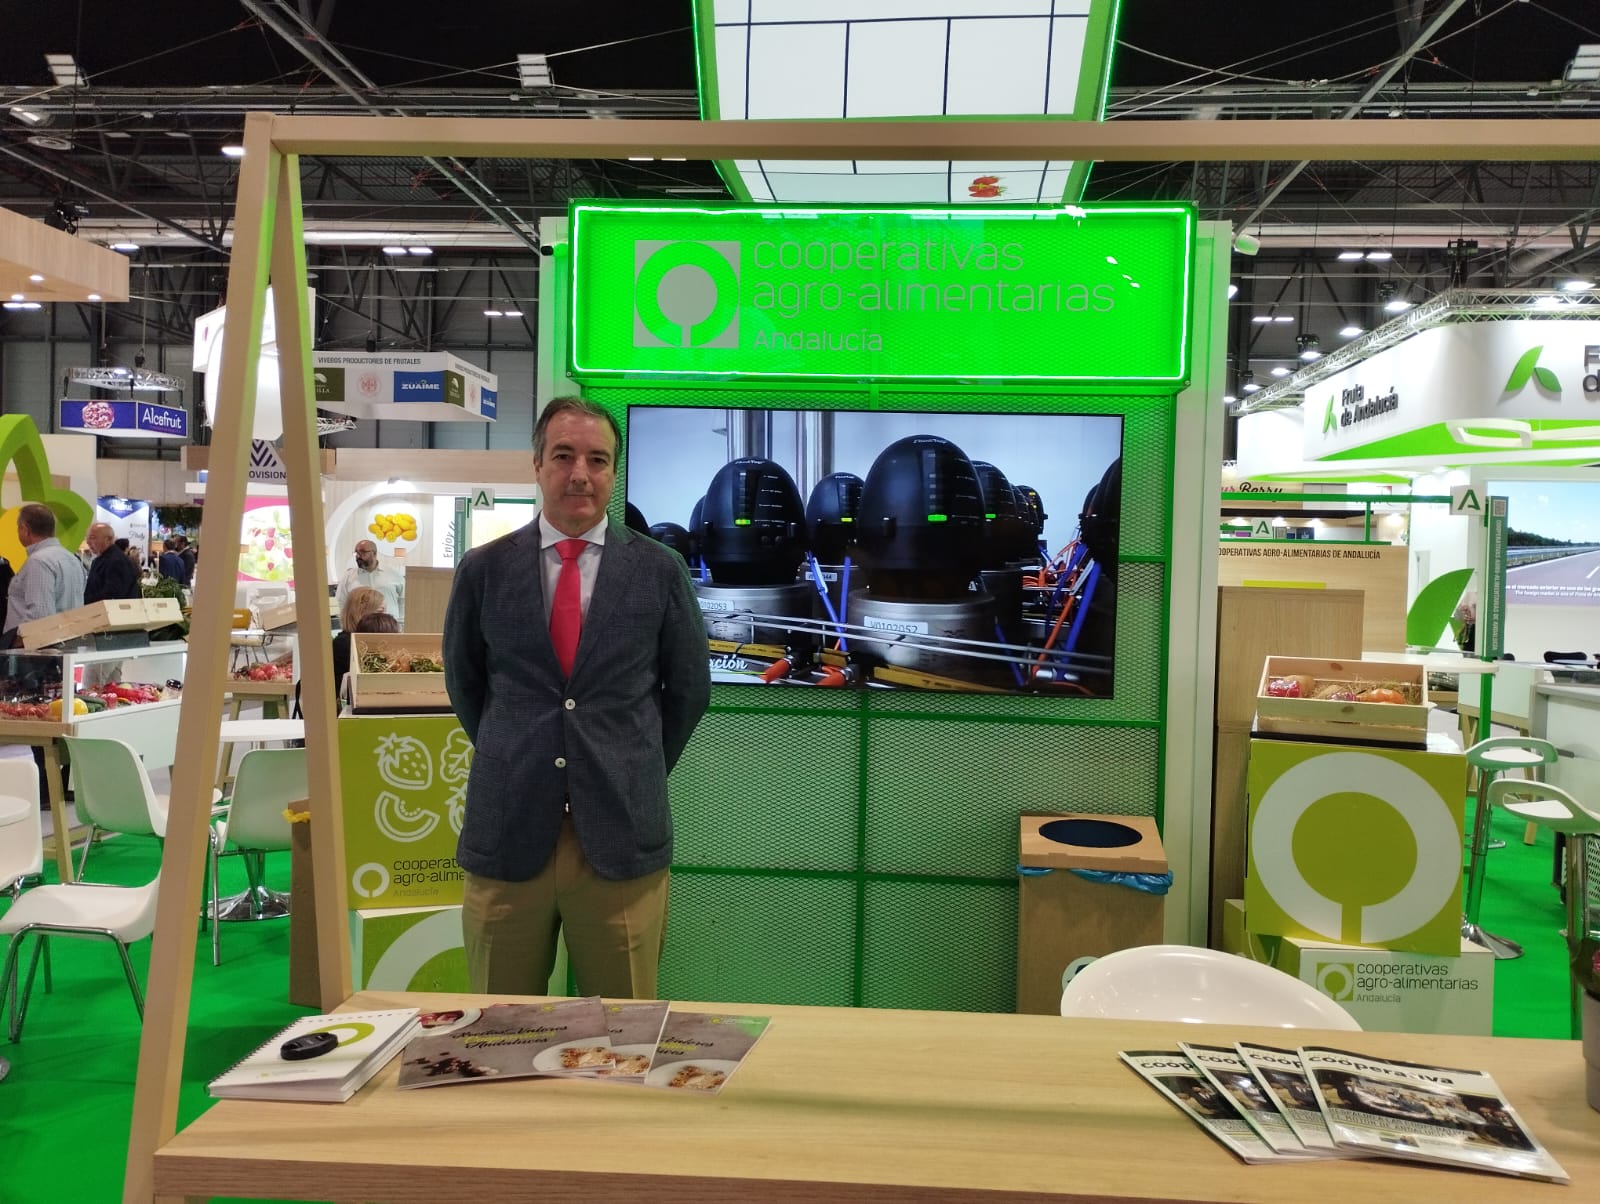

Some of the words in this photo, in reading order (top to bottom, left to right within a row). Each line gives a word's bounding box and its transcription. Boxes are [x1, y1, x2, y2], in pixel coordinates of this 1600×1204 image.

[753, 238, 1025, 275] cooperativas
[753, 279, 1116, 319] agro-alimentarias
[752, 327, 883, 352] Andalucía
[318, 356, 342, 364] VIVEROS
[342, 357, 383, 365] PRODUCTORES
[1340, 407, 1352, 427] de
[1353, 386, 1398, 423] Andalucía
[1341, 383, 1364, 407] Fruta
[142, 407, 182, 429] Alcafruit
[1263, 549, 1330, 558] AGRO-ALIMENTARIAS
[1342, 549, 1381, 560] ANDALUCÍA
[1357, 962, 1448, 976] cooperativas
[1357, 976, 1479, 992] agro-alimentarias
